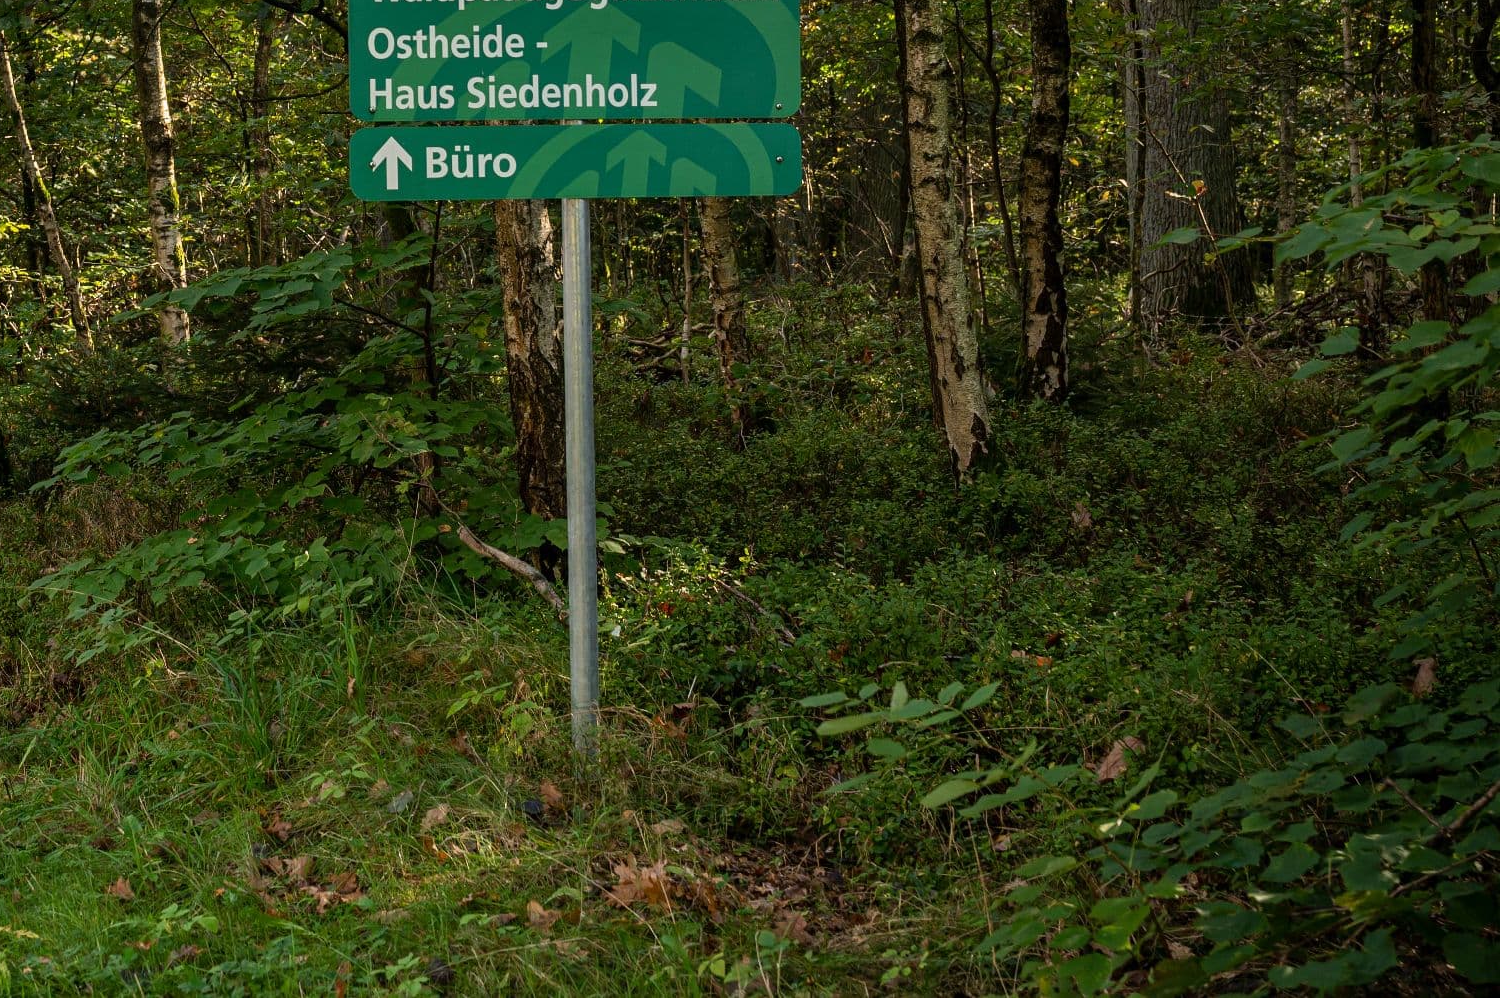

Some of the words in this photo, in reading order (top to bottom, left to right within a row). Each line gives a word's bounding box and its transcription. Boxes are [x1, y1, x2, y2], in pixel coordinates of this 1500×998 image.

[367, 24, 525, 60] Ostheide
[368, 77, 456, 111] Haus
[466, 73, 659, 109] Siedenholz
[425, 144, 518, 179] Büro
